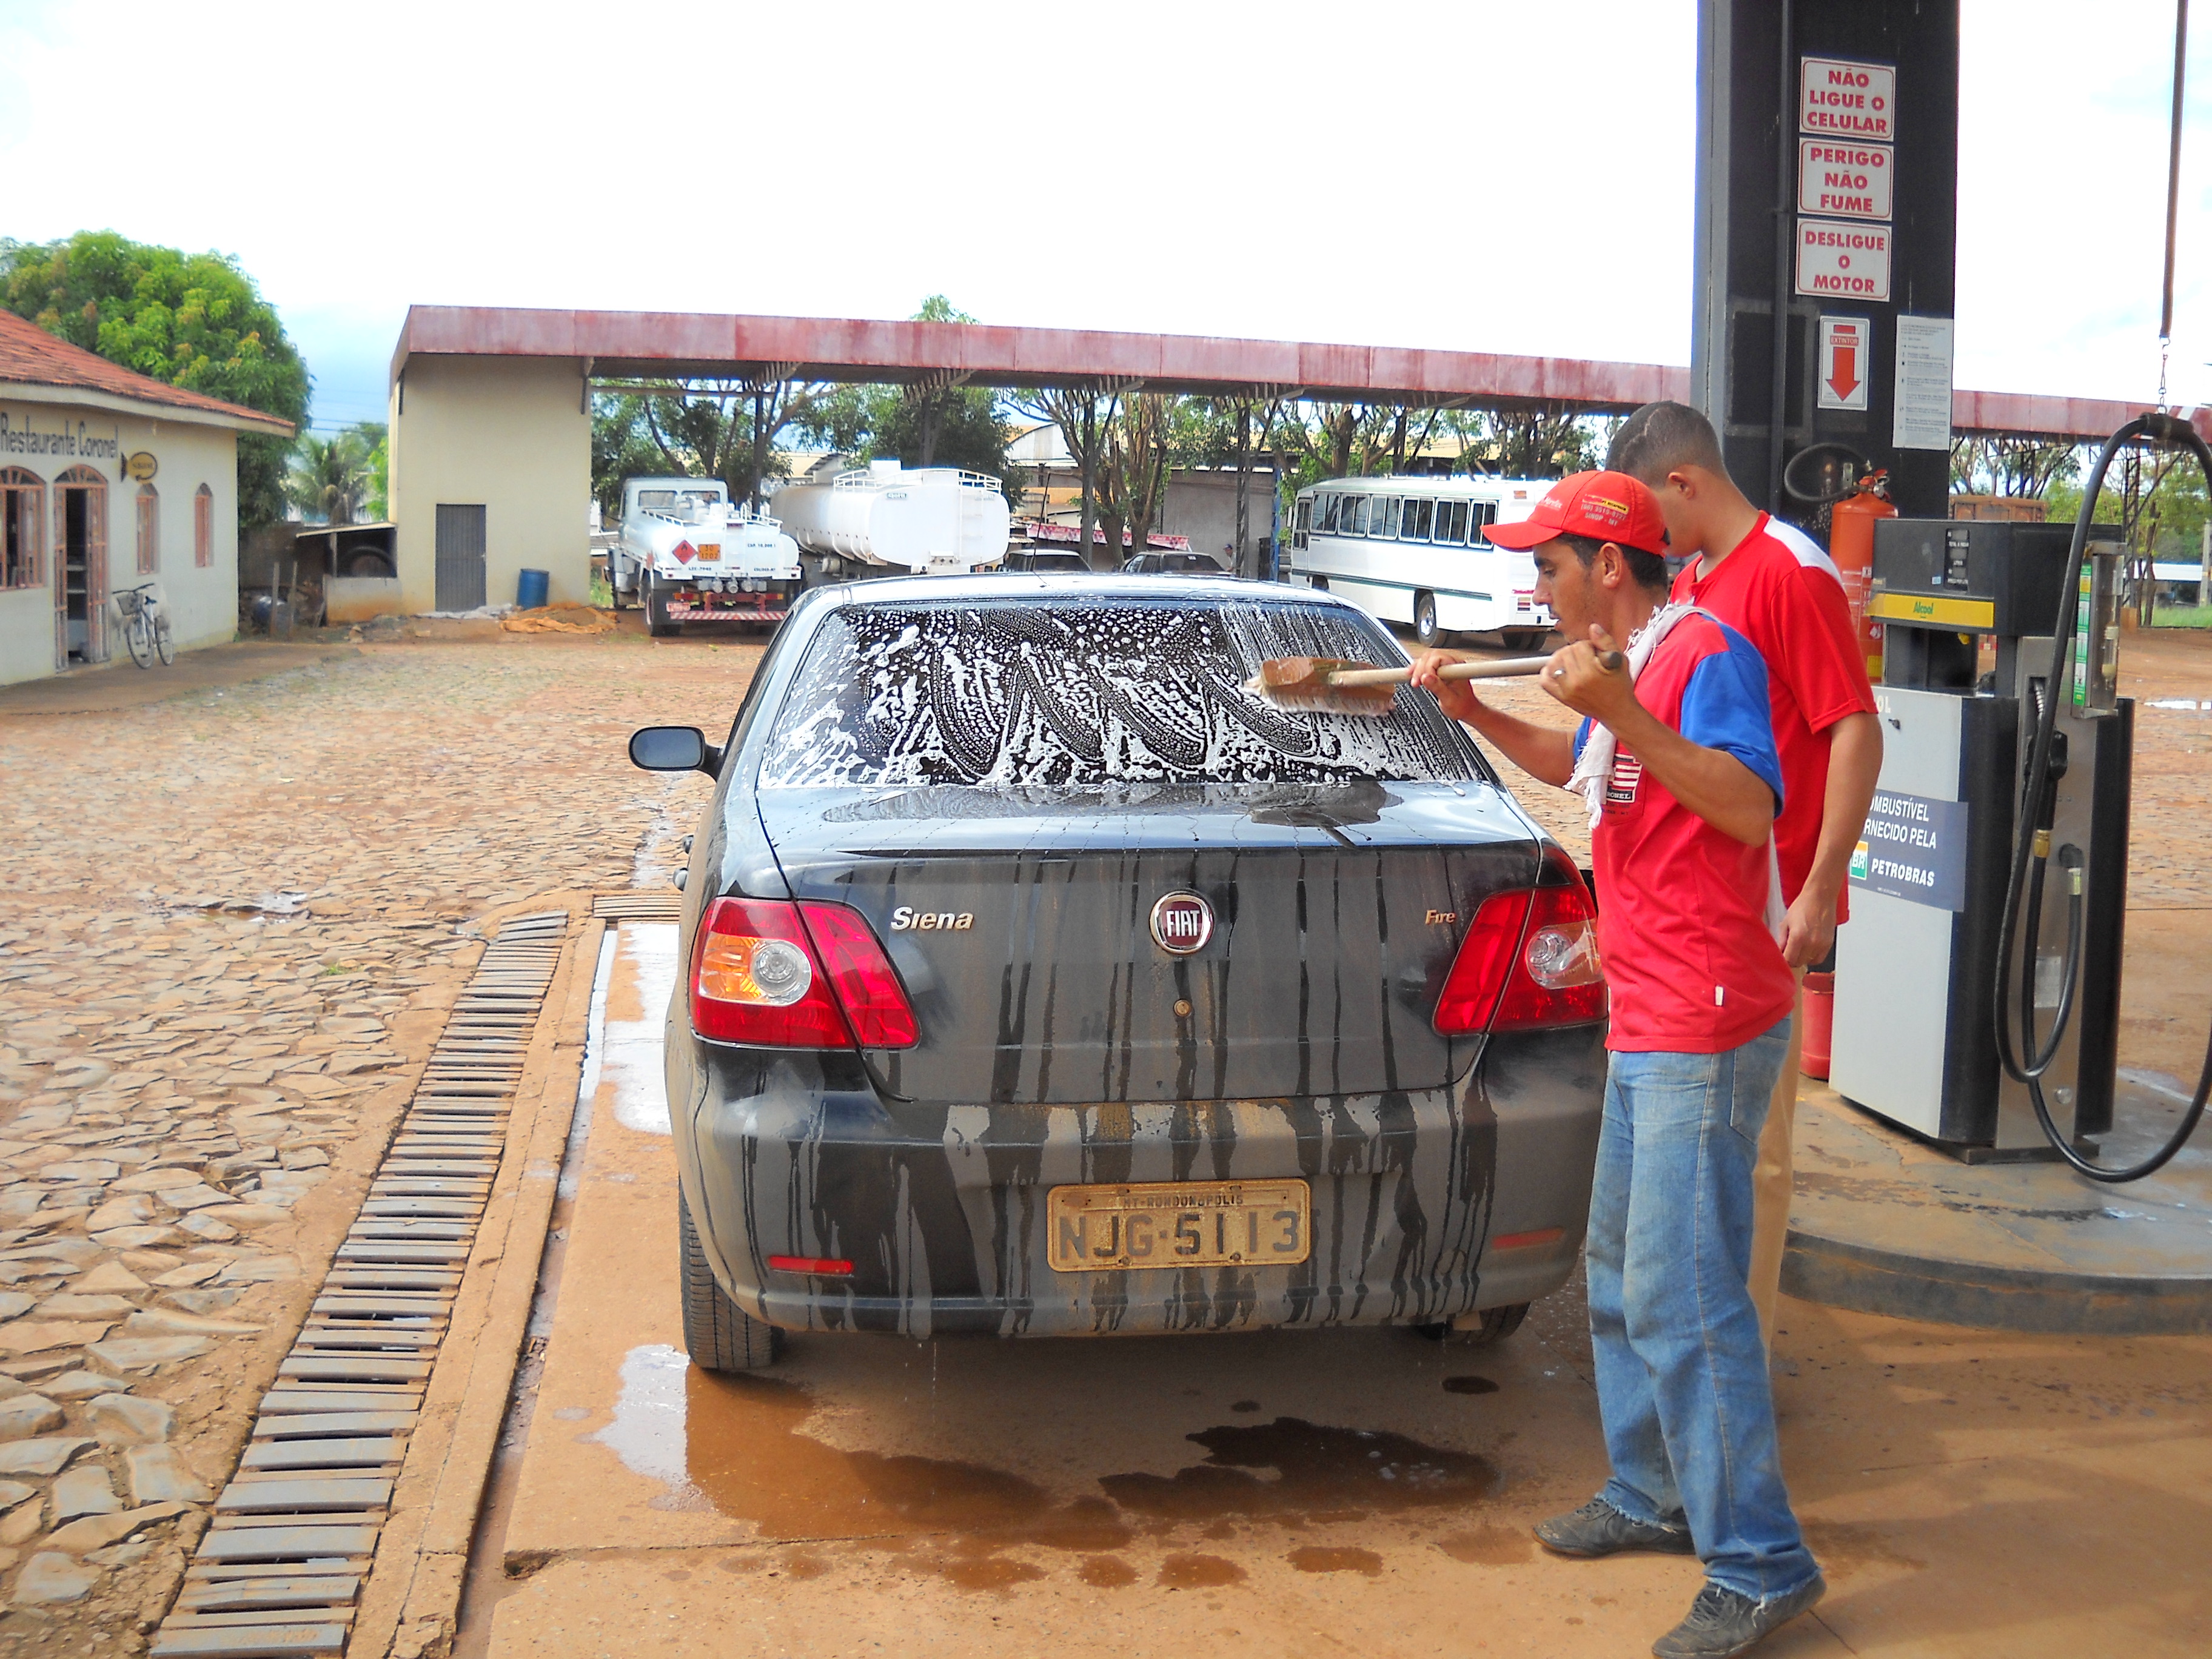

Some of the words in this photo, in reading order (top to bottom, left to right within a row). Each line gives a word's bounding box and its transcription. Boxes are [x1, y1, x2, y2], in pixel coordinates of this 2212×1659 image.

[1828, 69, 1869, 88] NÃO
[1809, 90, 1865, 110] LIGUE
[1871, 96, 1885, 111] O
[1806, 112, 1887, 134] CELULAR
[1810, 147, 1885, 167] PERIGO
[1824, 170, 1868, 190] NÃO
[1820, 194, 1872, 213] FUME
[1805, 231, 1885, 251] DESLIGUE
[1838, 255, 1850, 269] O
[1814, 275, 1874, 293] MOTOR
[1831, 337, 1857, 346] EXTINTOR
[1, 412, 76, 456] Restaurante
[79, 420, 118, 458] Coronel
[1876, 695, 1891, 713] OL
[1870, 796, 1929, 822] MBUSTÍVEL
[1864, 818, 1908, 843] RNECIDO
[1909, 827, 1936, 849] PELA
[1852, 854, 1865, 870] BR
[1871, 858, 1935, 887] PETROBRAS
[891, 907, 974, 931] Siena
[1166, 910, 1200, 937] FIAT
[1425, 910, 1456, 925] Fire
